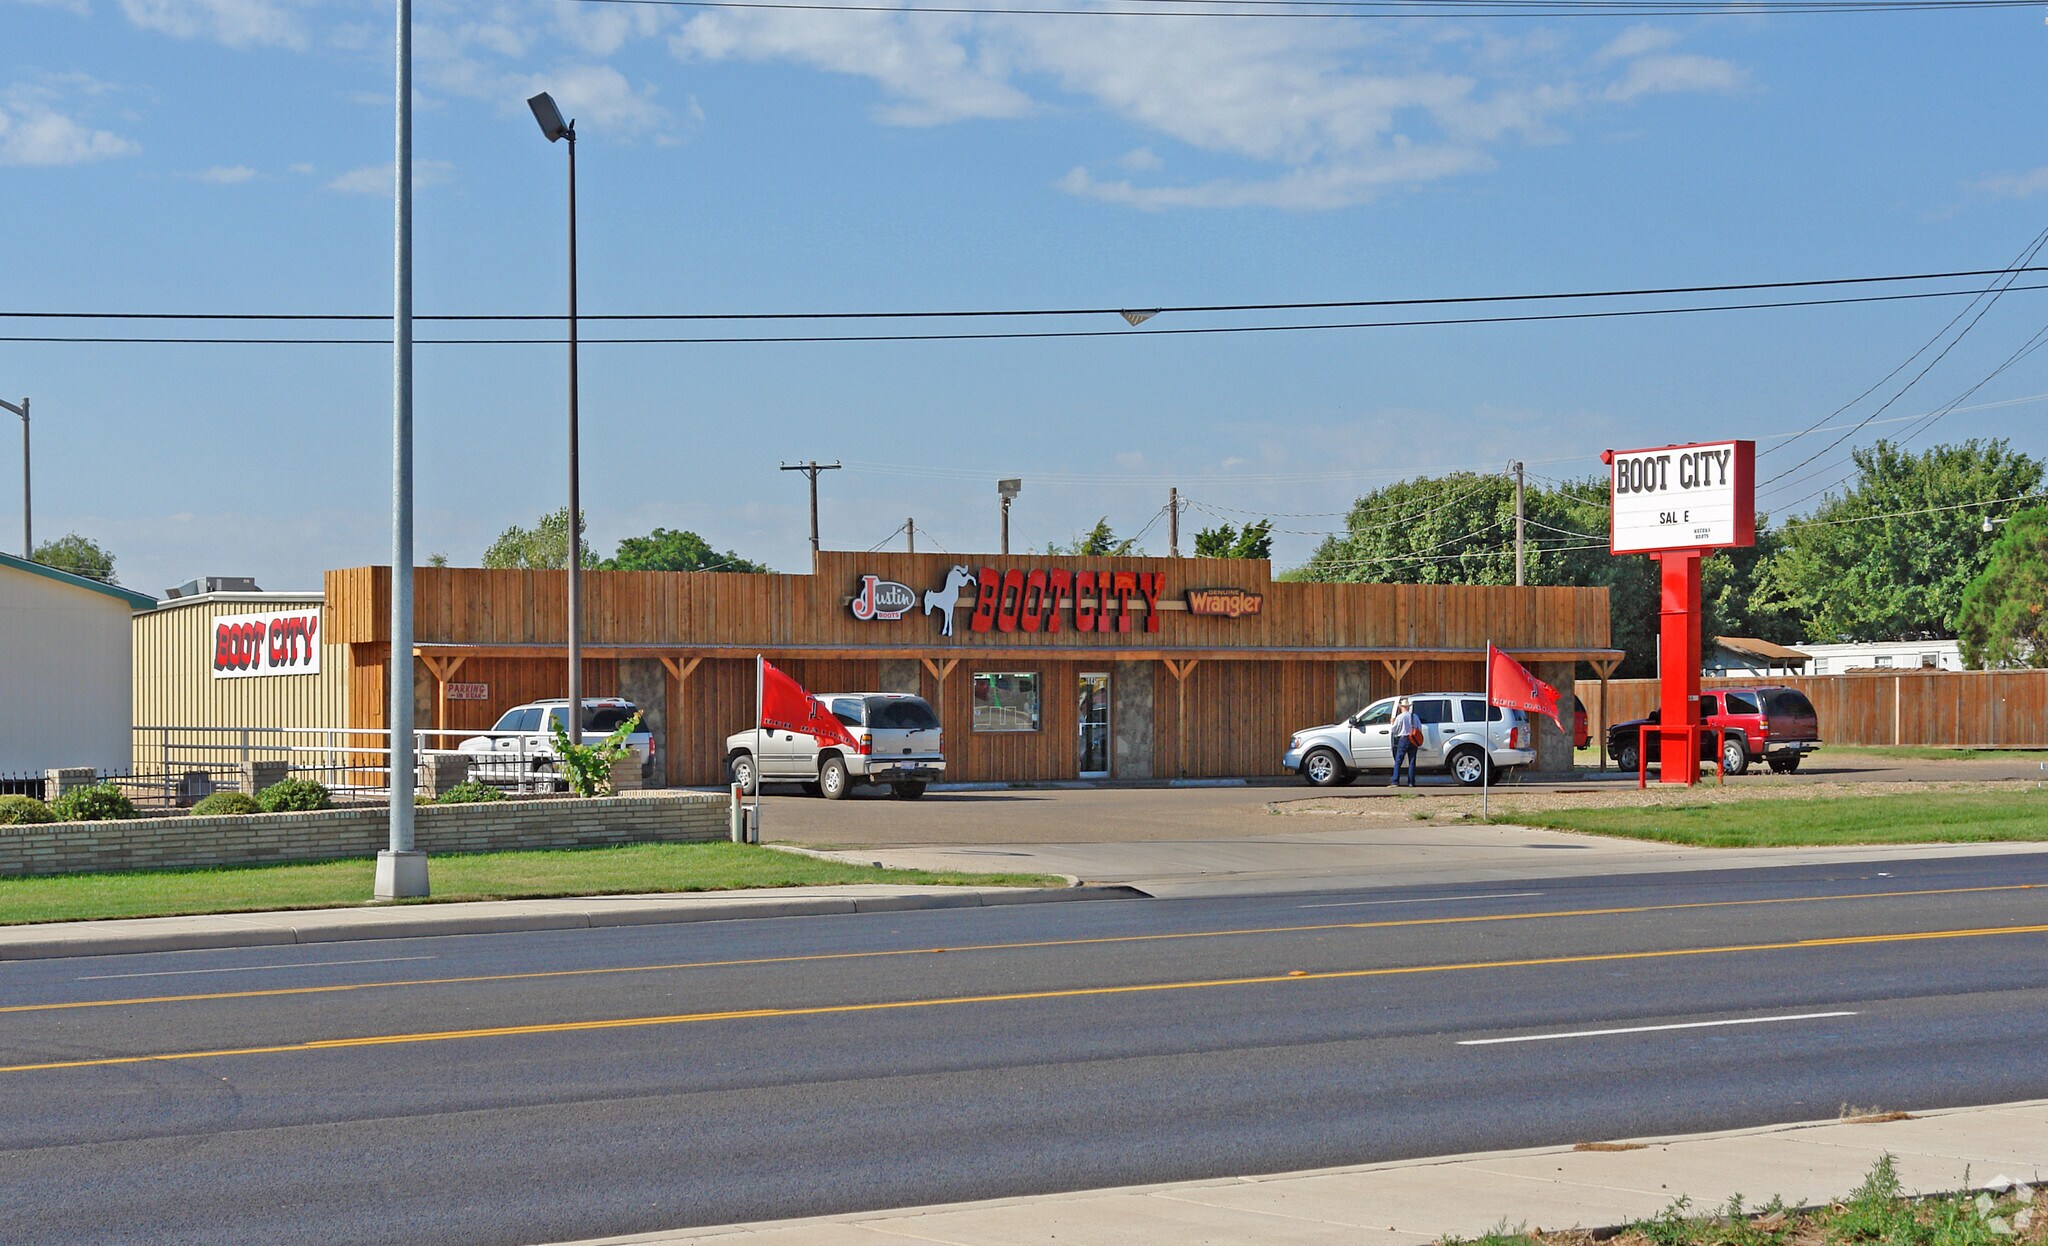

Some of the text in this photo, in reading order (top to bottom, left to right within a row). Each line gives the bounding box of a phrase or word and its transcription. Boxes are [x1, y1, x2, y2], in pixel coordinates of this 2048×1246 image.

[1616, 449, 1731, 494] BOOT CITY
[853, 576, 911, 618] Justin
[1189, 591, 1262, 618] Wrangler
[213, 615, 318, 672] BOOT CITY
[448, 684, 487, 694] PARKING
